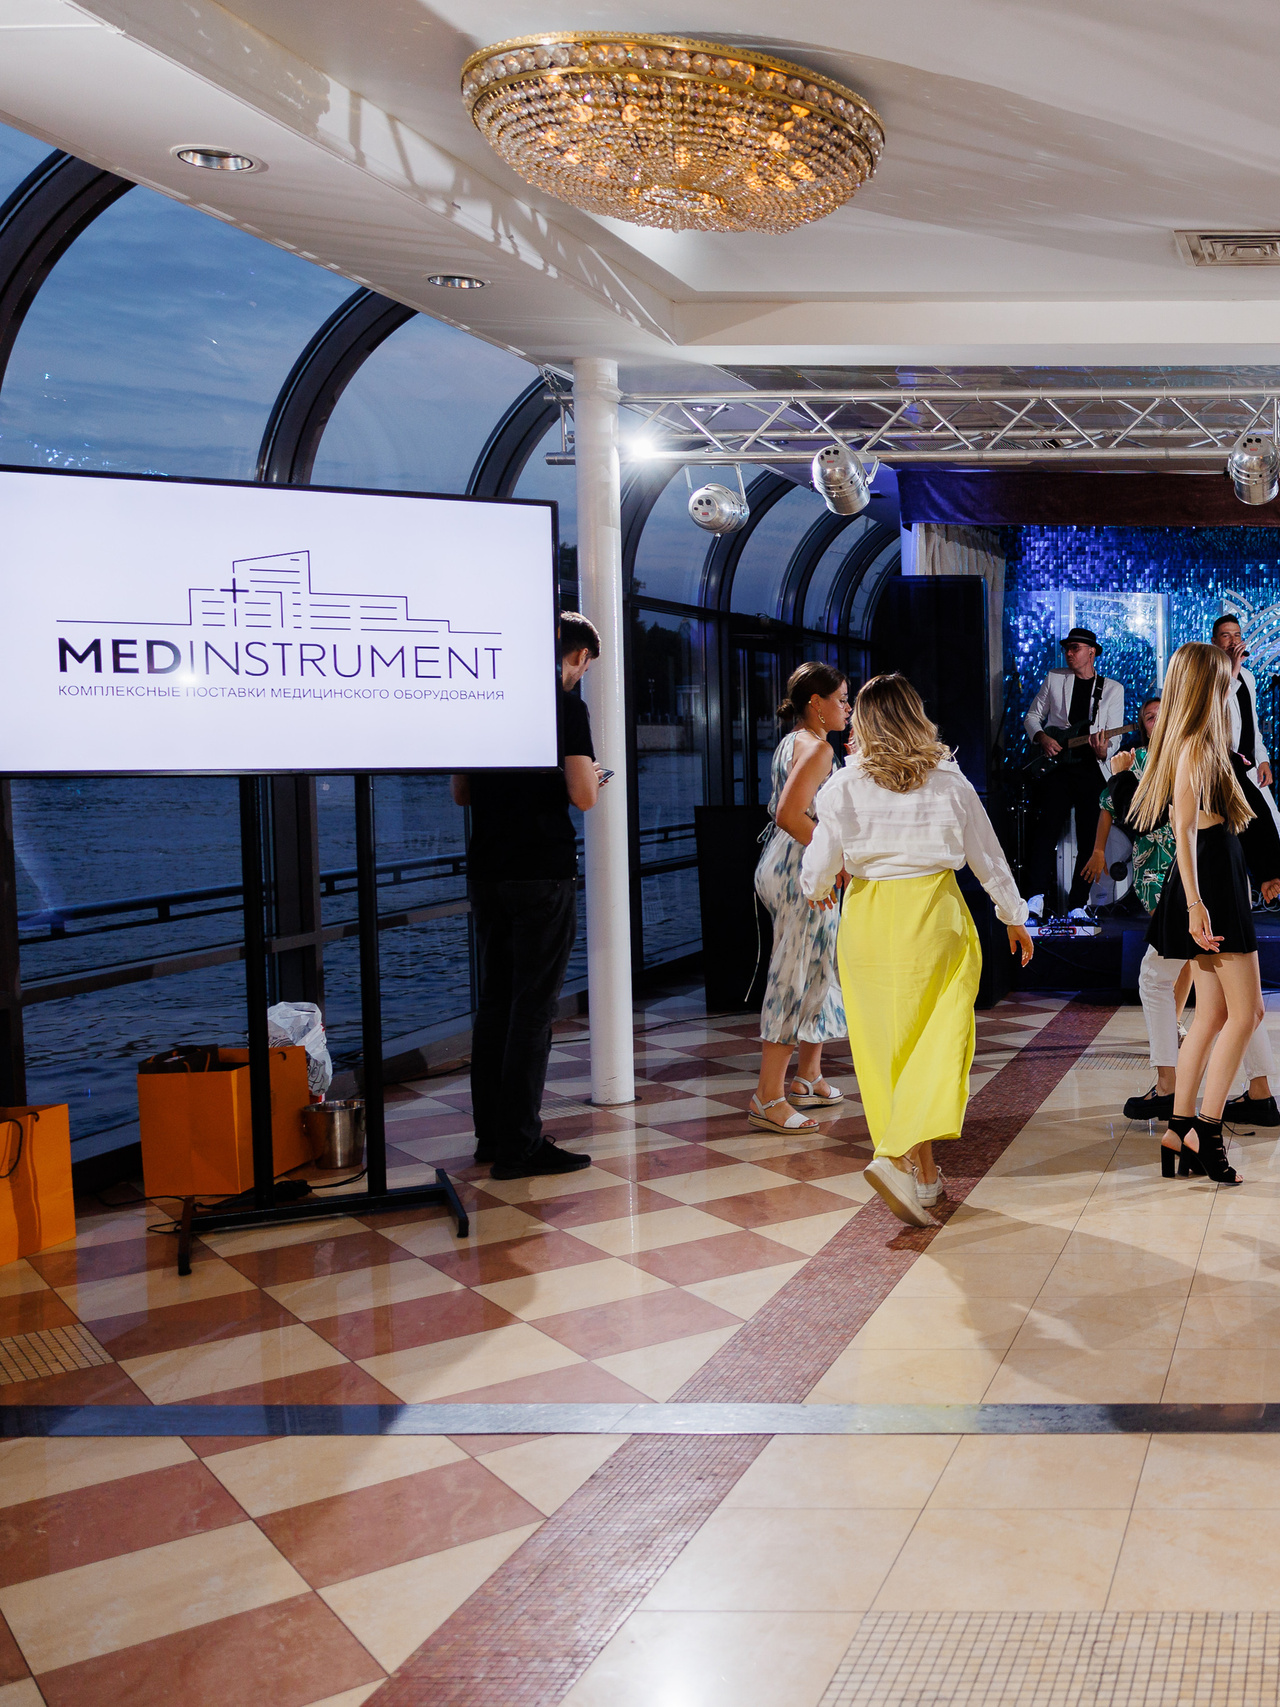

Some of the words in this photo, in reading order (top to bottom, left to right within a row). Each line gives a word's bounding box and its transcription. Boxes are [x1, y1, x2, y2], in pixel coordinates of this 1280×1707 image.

[58, 637, 503, 680] MEDINSTRUMENT
[58, 685, 182, 698] КОМПЛЕКСНЫЕ
[185, 686, 267, 699] ПОСТАВКИ
[270, 688, 390, 701] МЕДИЦИНСКОГО
[393, 689, 505, 702] ОБОРУДОВАНИЯ
